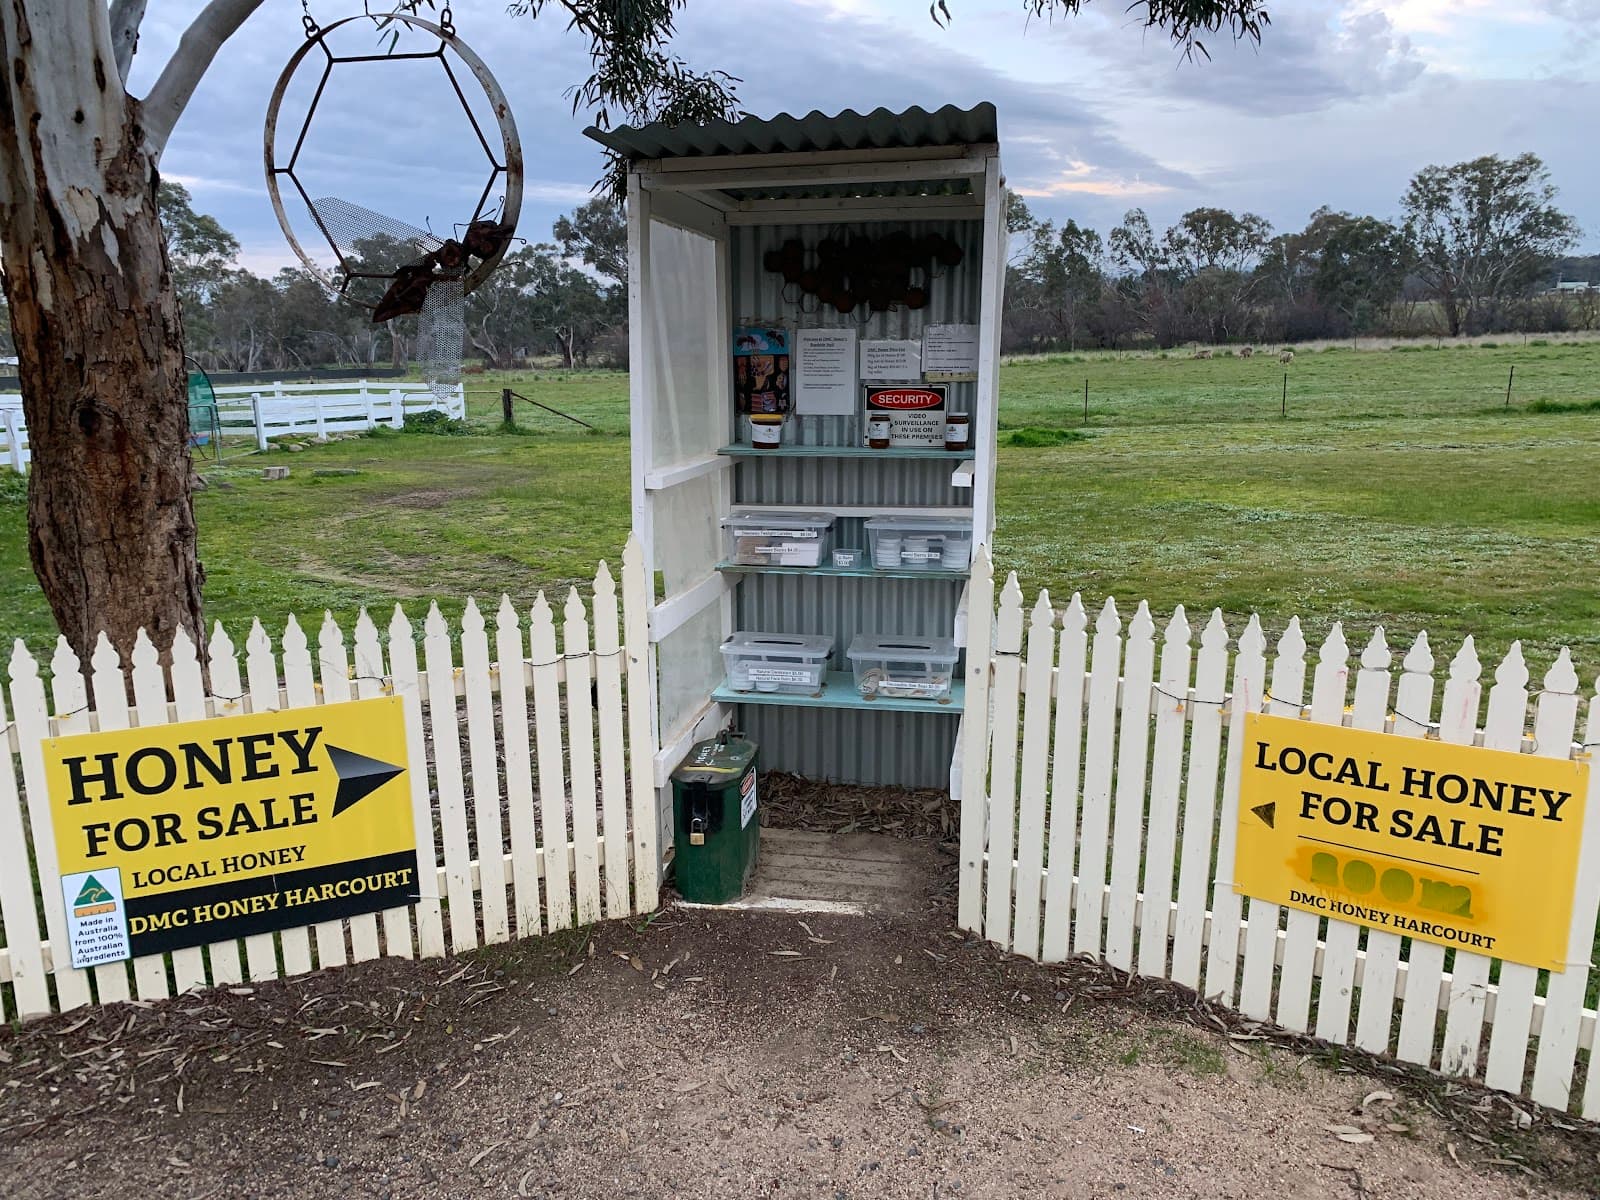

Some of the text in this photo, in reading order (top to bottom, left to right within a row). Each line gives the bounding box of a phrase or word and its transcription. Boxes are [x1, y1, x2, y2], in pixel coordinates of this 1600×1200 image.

[878, 394, 933, 404] SECURITY
[62, 727, 322, 806] HONEY
[1255, 742, 1572, 822] LOCAL HONEY
[82, 792, 318, 858] FOR SALE
[1299, 791, 1504, 857] FOR SALE
[132, 845, 307, 889] LOCAL HONEY
[80, 919, 103, 927] Made
[129, 867, 413, 936] DMC HONEY HARCOURT
[1289, 890, 1496, 950] DMC HONEY HARCOURT
[75, 933, 123, 946] from 100%
[78, 925, 118, 937] Australia
[78, 942, 123, 954] Australian
[76, 950, 126, 964] ingredients
